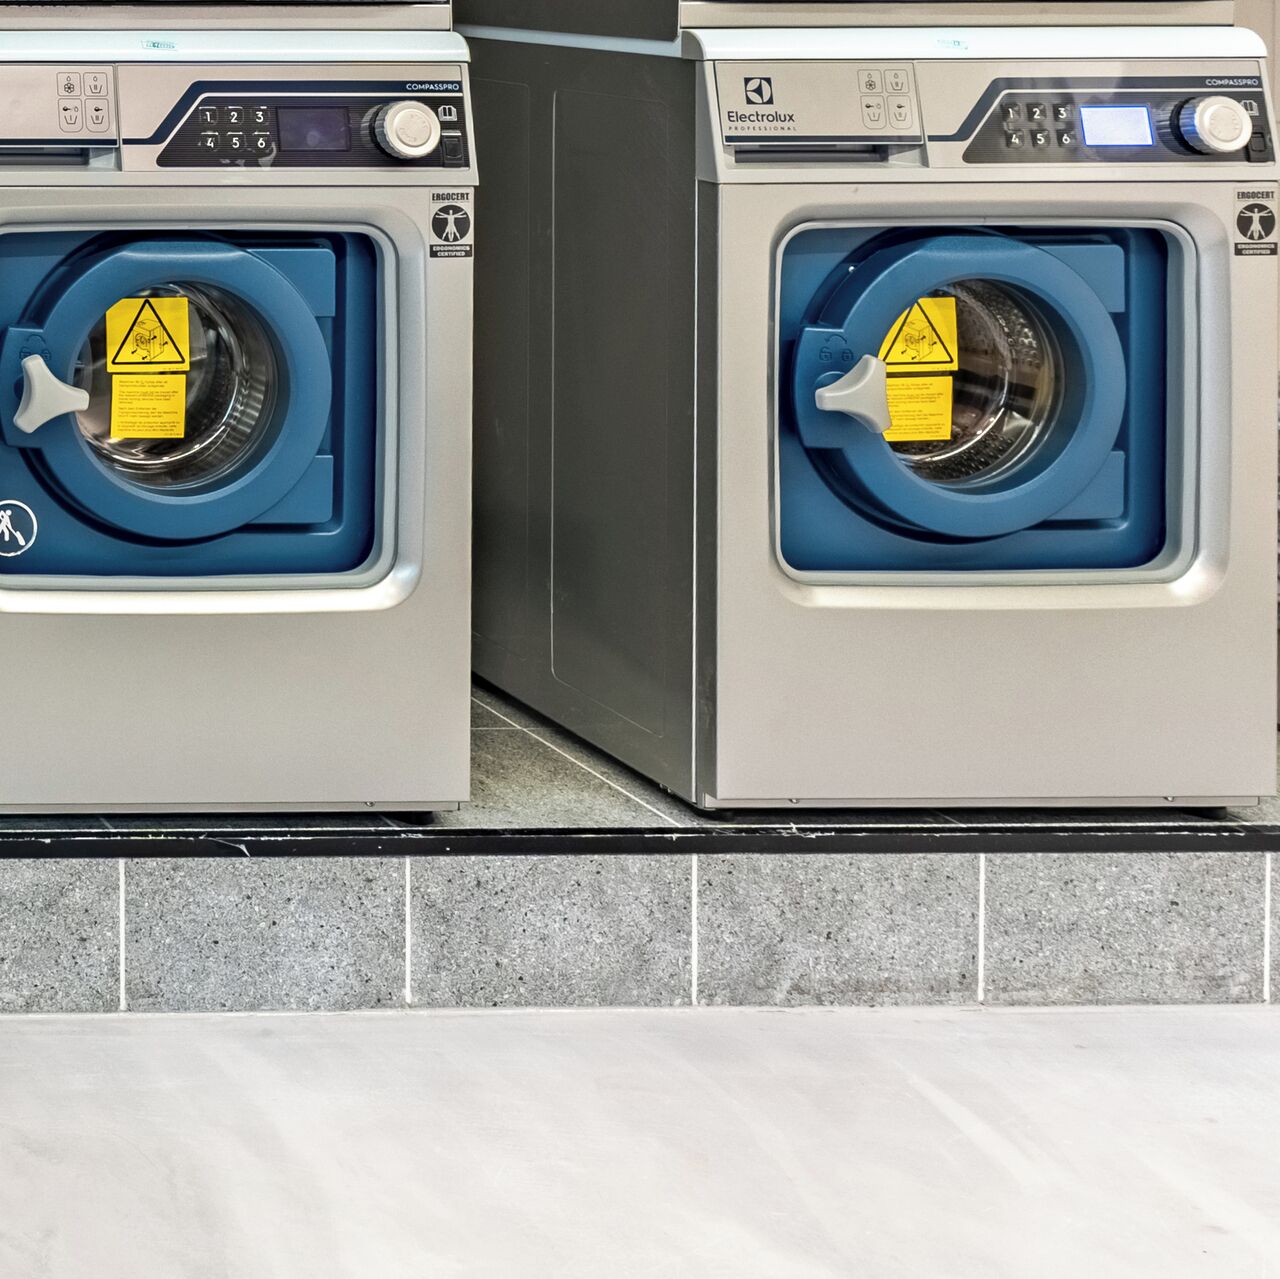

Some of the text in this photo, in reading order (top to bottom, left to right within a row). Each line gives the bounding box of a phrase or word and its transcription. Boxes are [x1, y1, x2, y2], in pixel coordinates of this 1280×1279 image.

[206, 111, 264, 123] 1 2 3
[727, 110, 795, 124] Electrolux
[1008, 108, 1067, 119] 1 2 3
[206, 137, 266, 148] 4 5 6
[1011, 133, 1070, 145] 4 5 6
[431, 192, 470, 201] ERGOCERT
[1237, 191, 1275, 200] ERGOCERT
